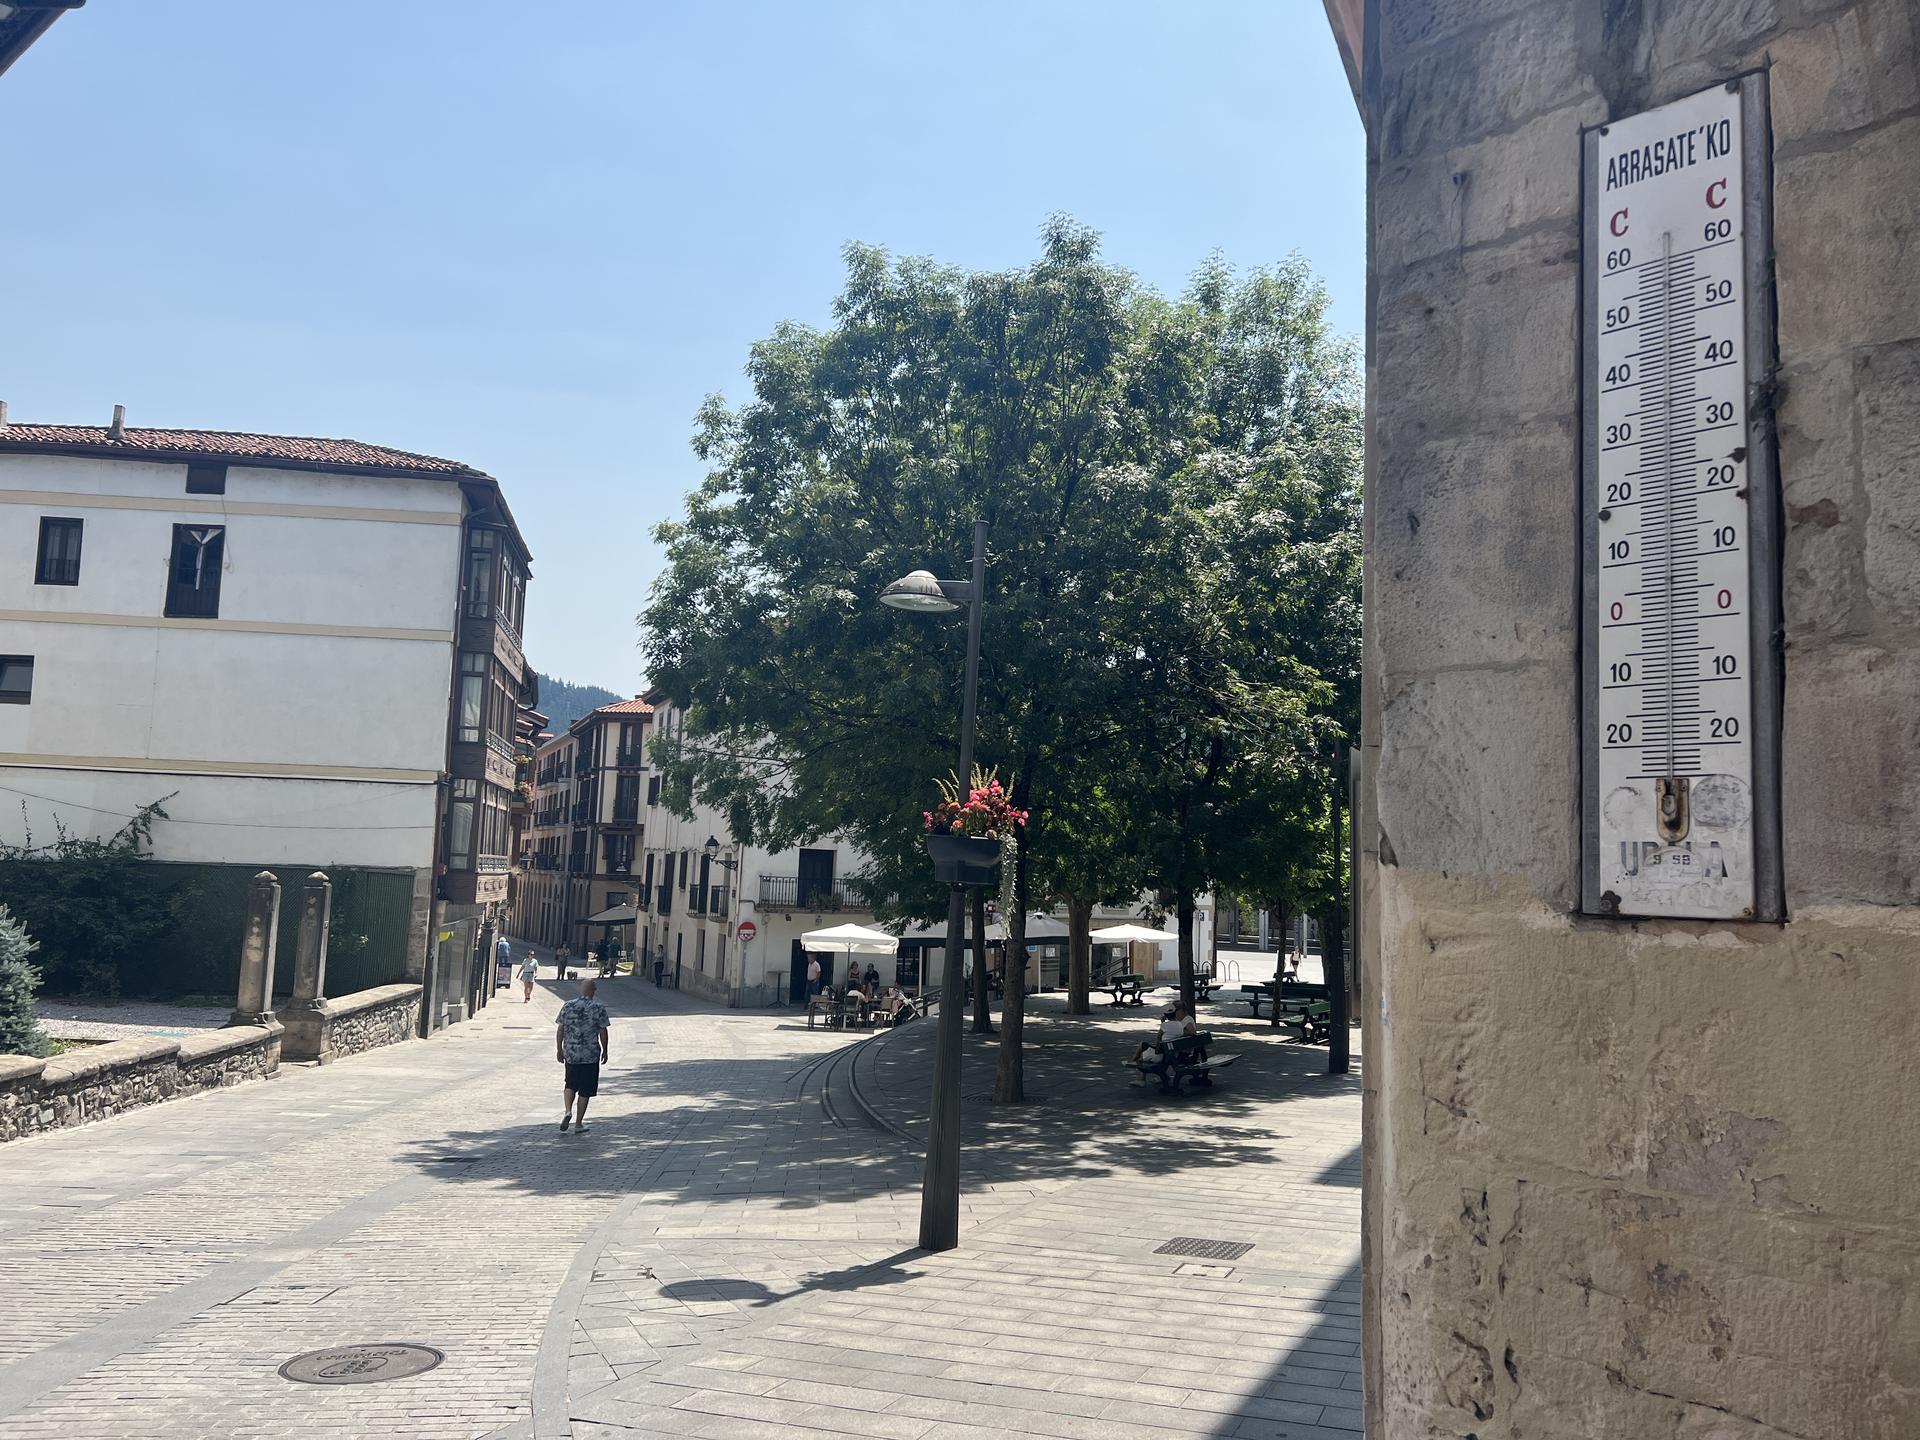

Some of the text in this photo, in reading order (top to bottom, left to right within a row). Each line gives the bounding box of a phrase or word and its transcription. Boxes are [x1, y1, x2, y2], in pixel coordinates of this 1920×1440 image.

[1606, 119, 1731, 192] ARRASATE'KO
[1705, 178, 1727, 209] C
[1610, 208, 1629, 237] C
[1704, 219, 1731, 241] 60
[1606, 248, 1631, 270] 60
[1705, 280, 1732, 302] 50
[1605, 306, 1630, 327] 50
[1704, 339, 1733, 362] 40
[1605, 364, 1630, 385] 40
[1706, 402, 1734, 424] 30
[1606, 423, 1631, 444] 30
[1707, 465, 1735, 486] 20
[1607, 482, 1631, 502] 20
[1713, 526, 1736, 548] 10
[1608, 541, 1629, 560] 10
[1717, 589, 1731, 609] 0
[1610, 602, 1623, 621] 0
[1610, 663, 1631, 682] 10
[1712, 655, 1736, 675] 10
[1606, 724, 1632, 744] 20
[1710, 717, 1739, 738] 20
